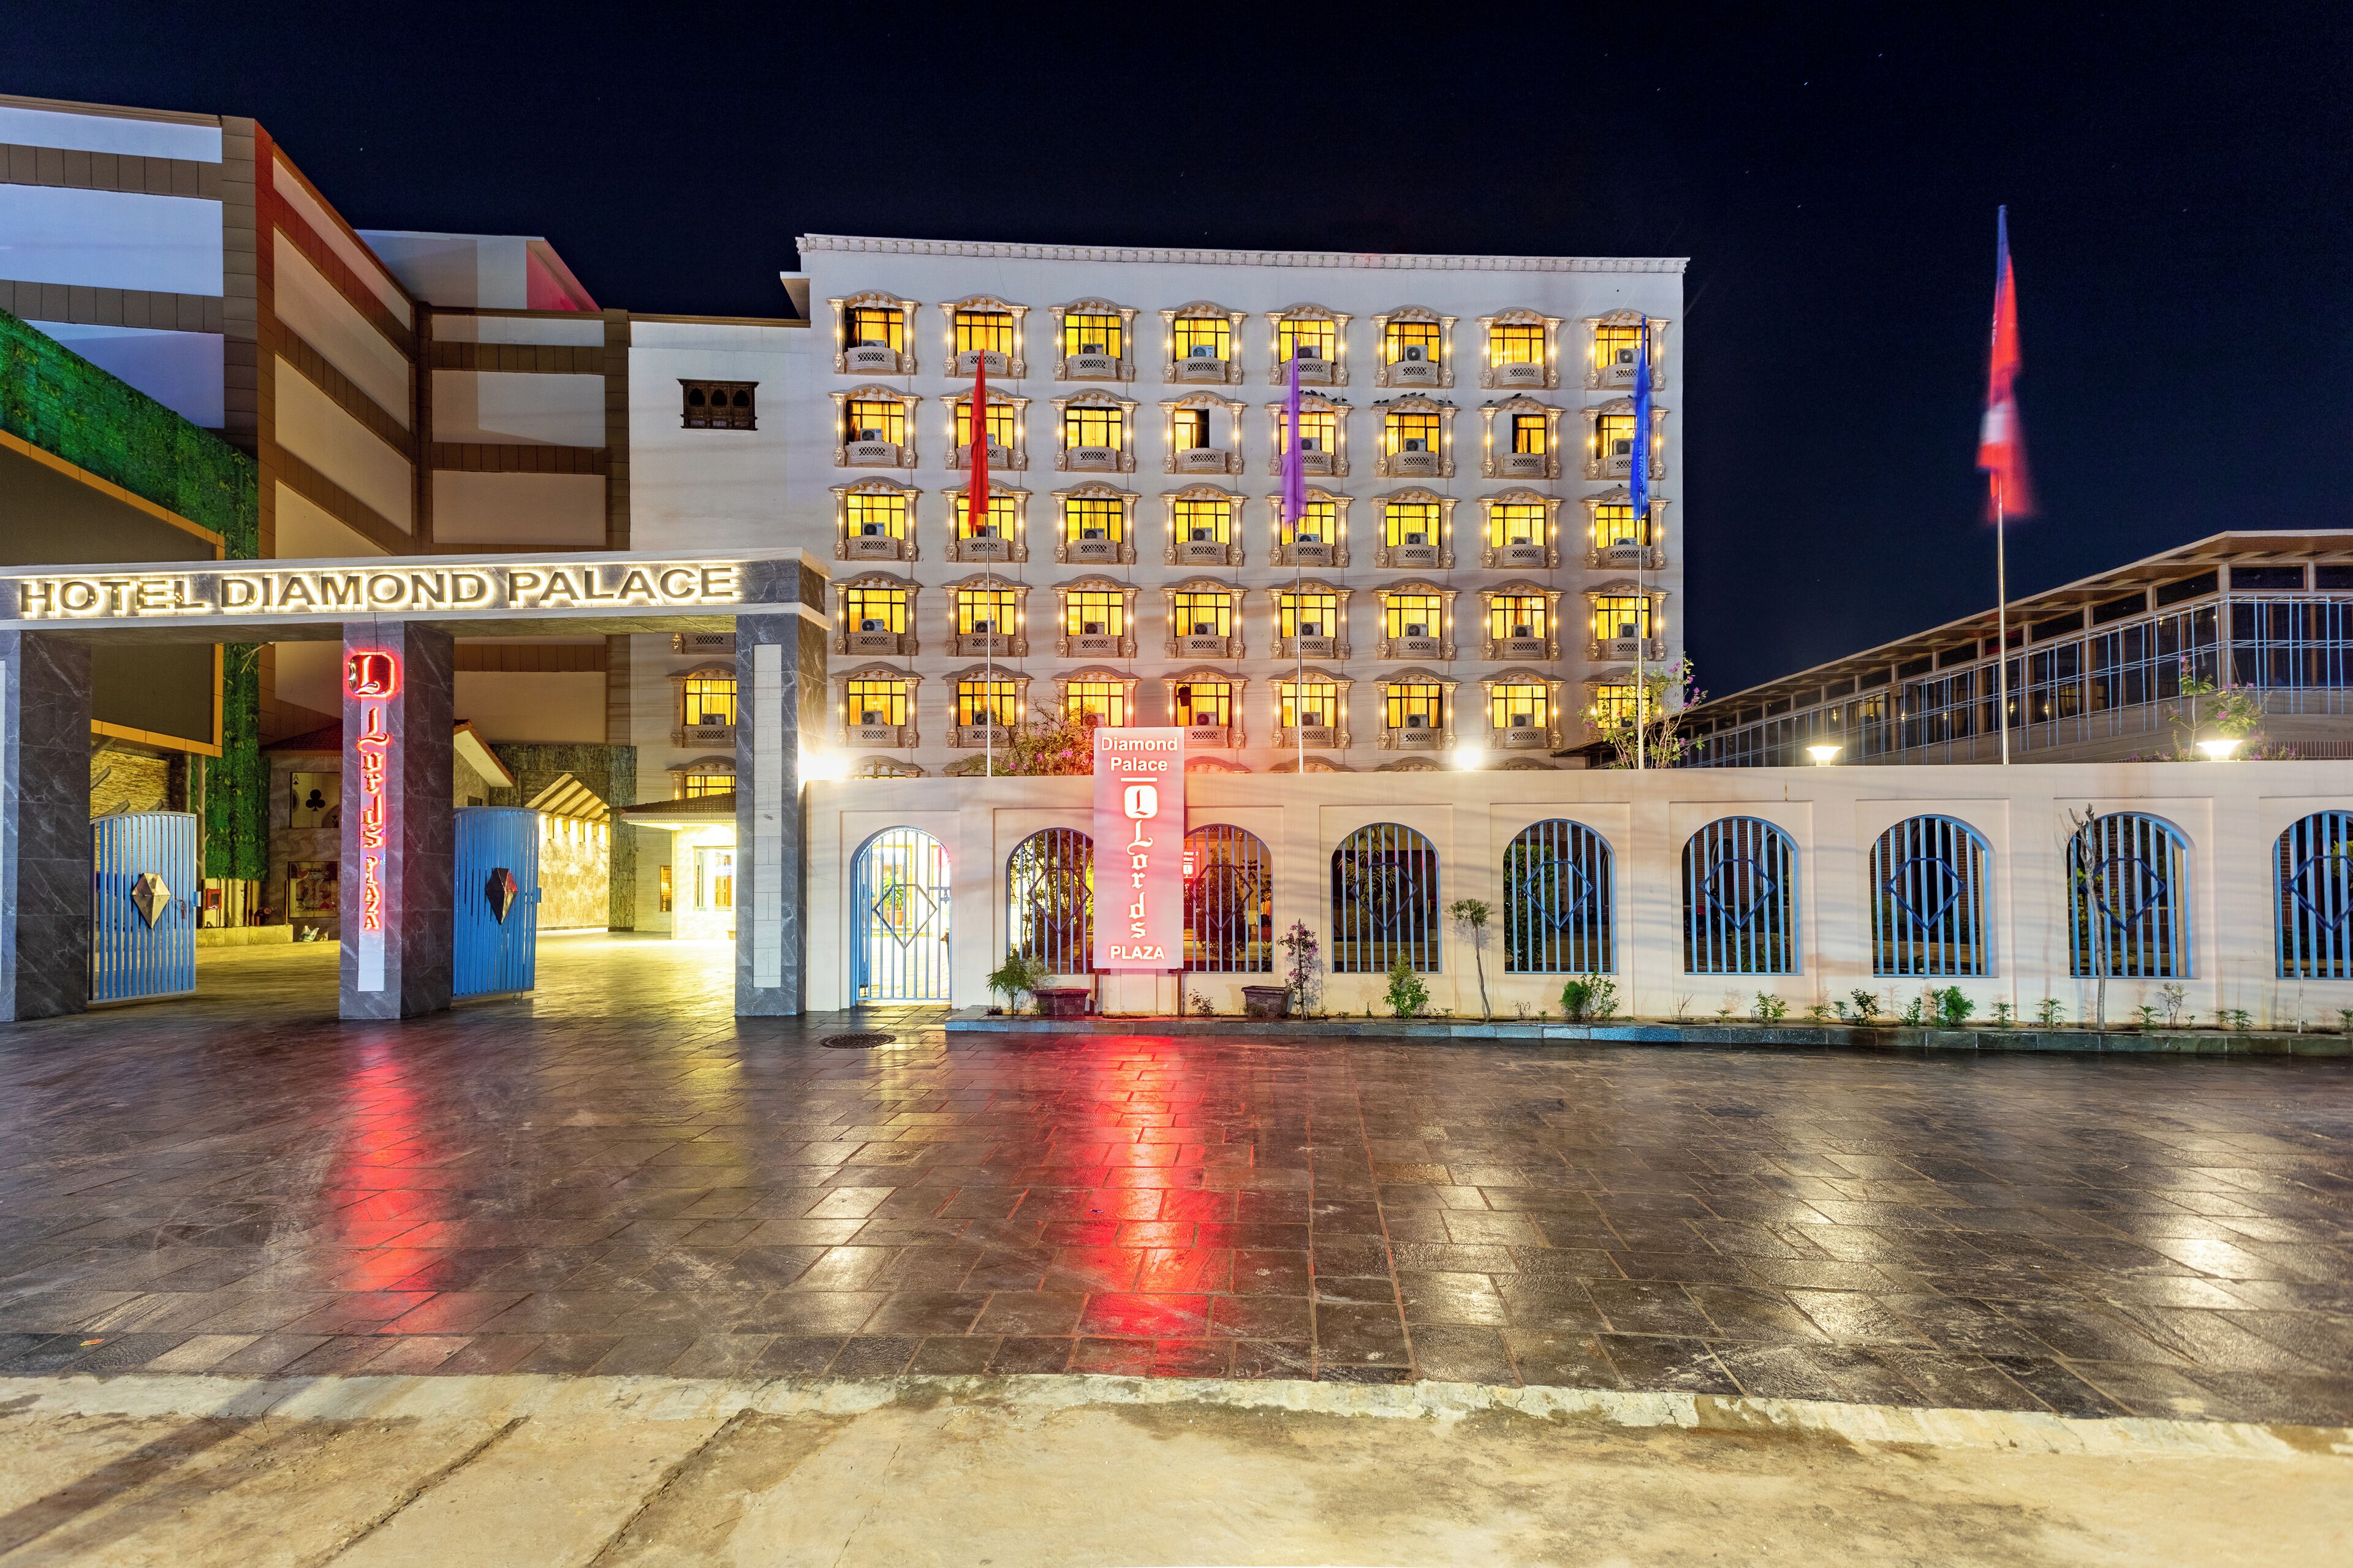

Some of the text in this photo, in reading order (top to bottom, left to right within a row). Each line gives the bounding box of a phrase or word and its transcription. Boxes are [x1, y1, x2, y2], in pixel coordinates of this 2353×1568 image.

[20, 567, 733, 612] HOTEL DIAMOND PALACE
[1101, 737, 1178, 751] Diamond
[1110, 757, 1168, 771] Palace
[1134, 789, 1149, 816] L
[356, 706, 390, 931] Lords PLAZA
[1126, 819, 1154, 939] Lords
[1110, 945, 1165, 960] PLAZA
